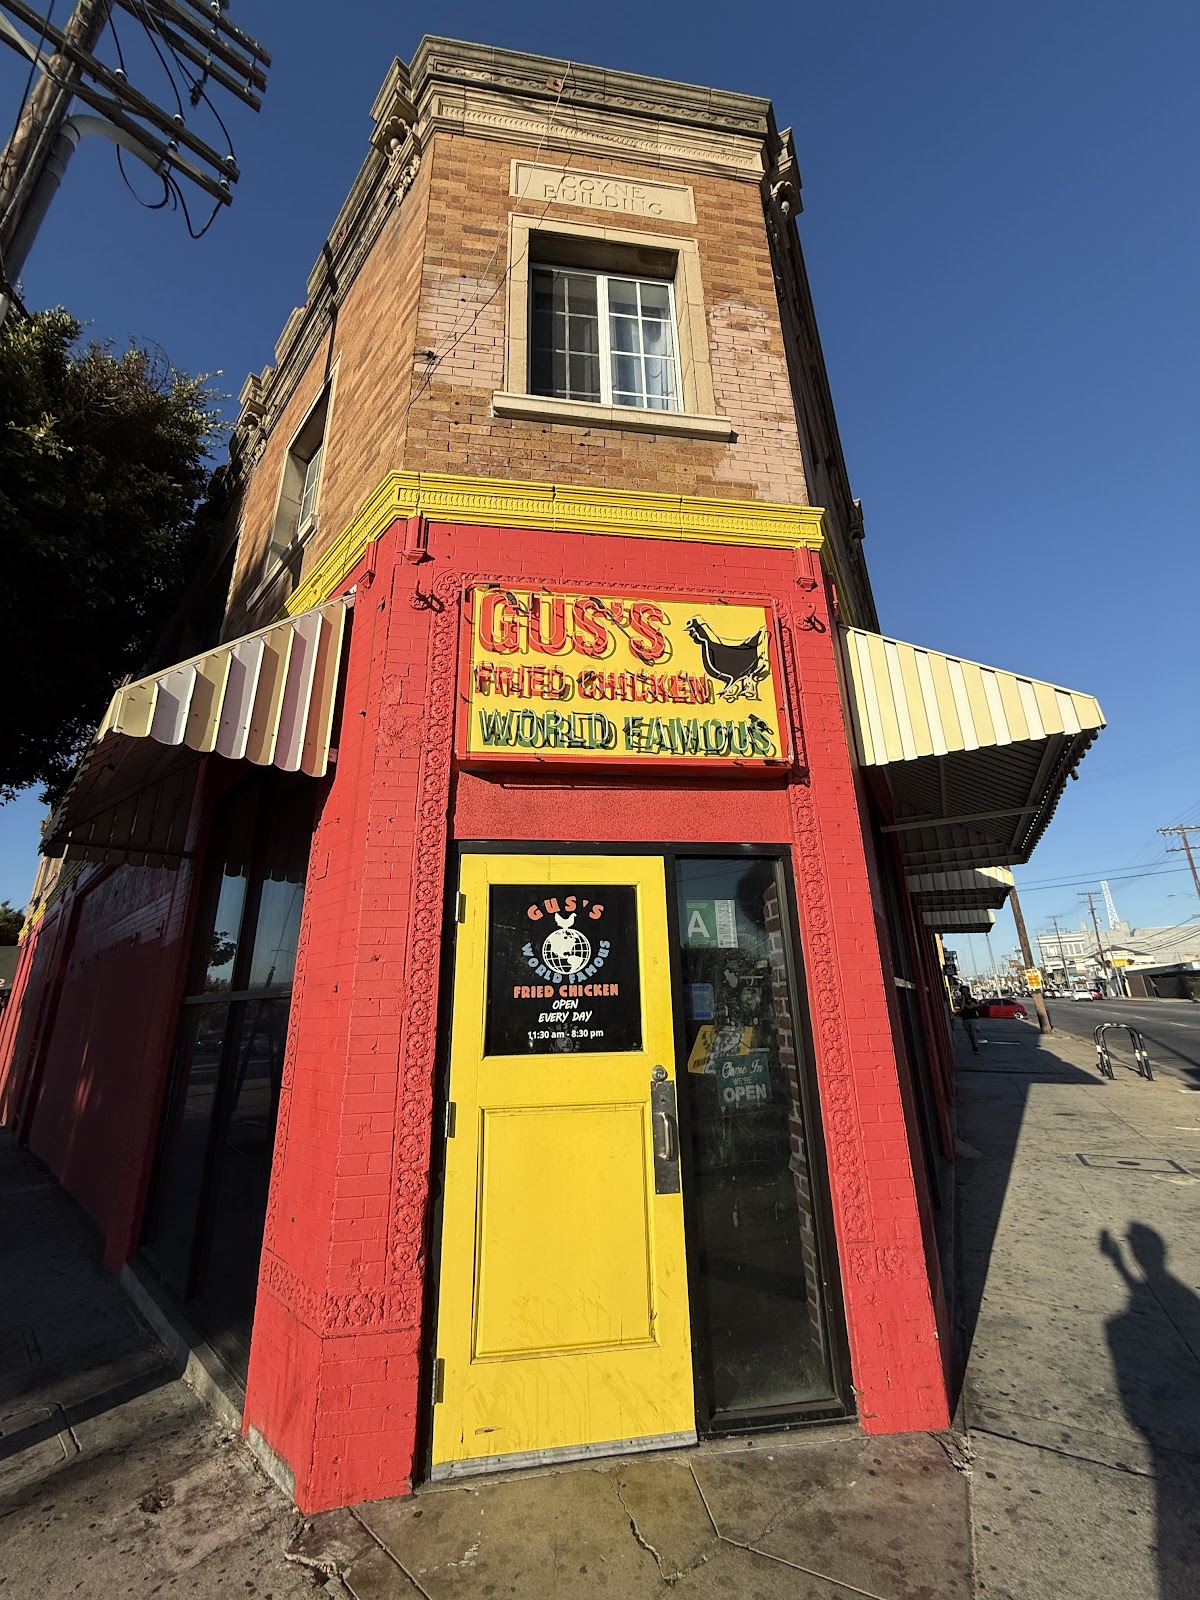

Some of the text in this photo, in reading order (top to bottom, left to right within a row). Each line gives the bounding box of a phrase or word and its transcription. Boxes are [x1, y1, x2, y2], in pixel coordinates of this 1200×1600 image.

[561, 175, 645, 199] COYNE
[544, 185, 663, 215] BUILDING
[479, 588, 672, 664] GUS'S
[474, 660, 715, 704] FRIED CHICKEN
[478, 707, 777, 758] WORLD FAMOUS
[527, 895, 604, 921] GUS'S
[687, 910, 710, 938] A
[521, 940, 611, 984] WORLD FAMOUS
[513, 983, 619, 999] FRIED CHICKEN
[552, 998, 579, 1010] OPEN
[538, 1010, 593, 1023] EVERY DAY
[527, 1030, 550, 1040] 11:30
[551, 1031, 565, 1039] am
[571, 1029, 588, 1038] 8:30
[589, 1029, 604, 1040] pm
[722, 1058, 763, 1078] Come In
[732, 1076, 753, 1085] WE'RE
[723, 1083, 767, 1103] OPEN
